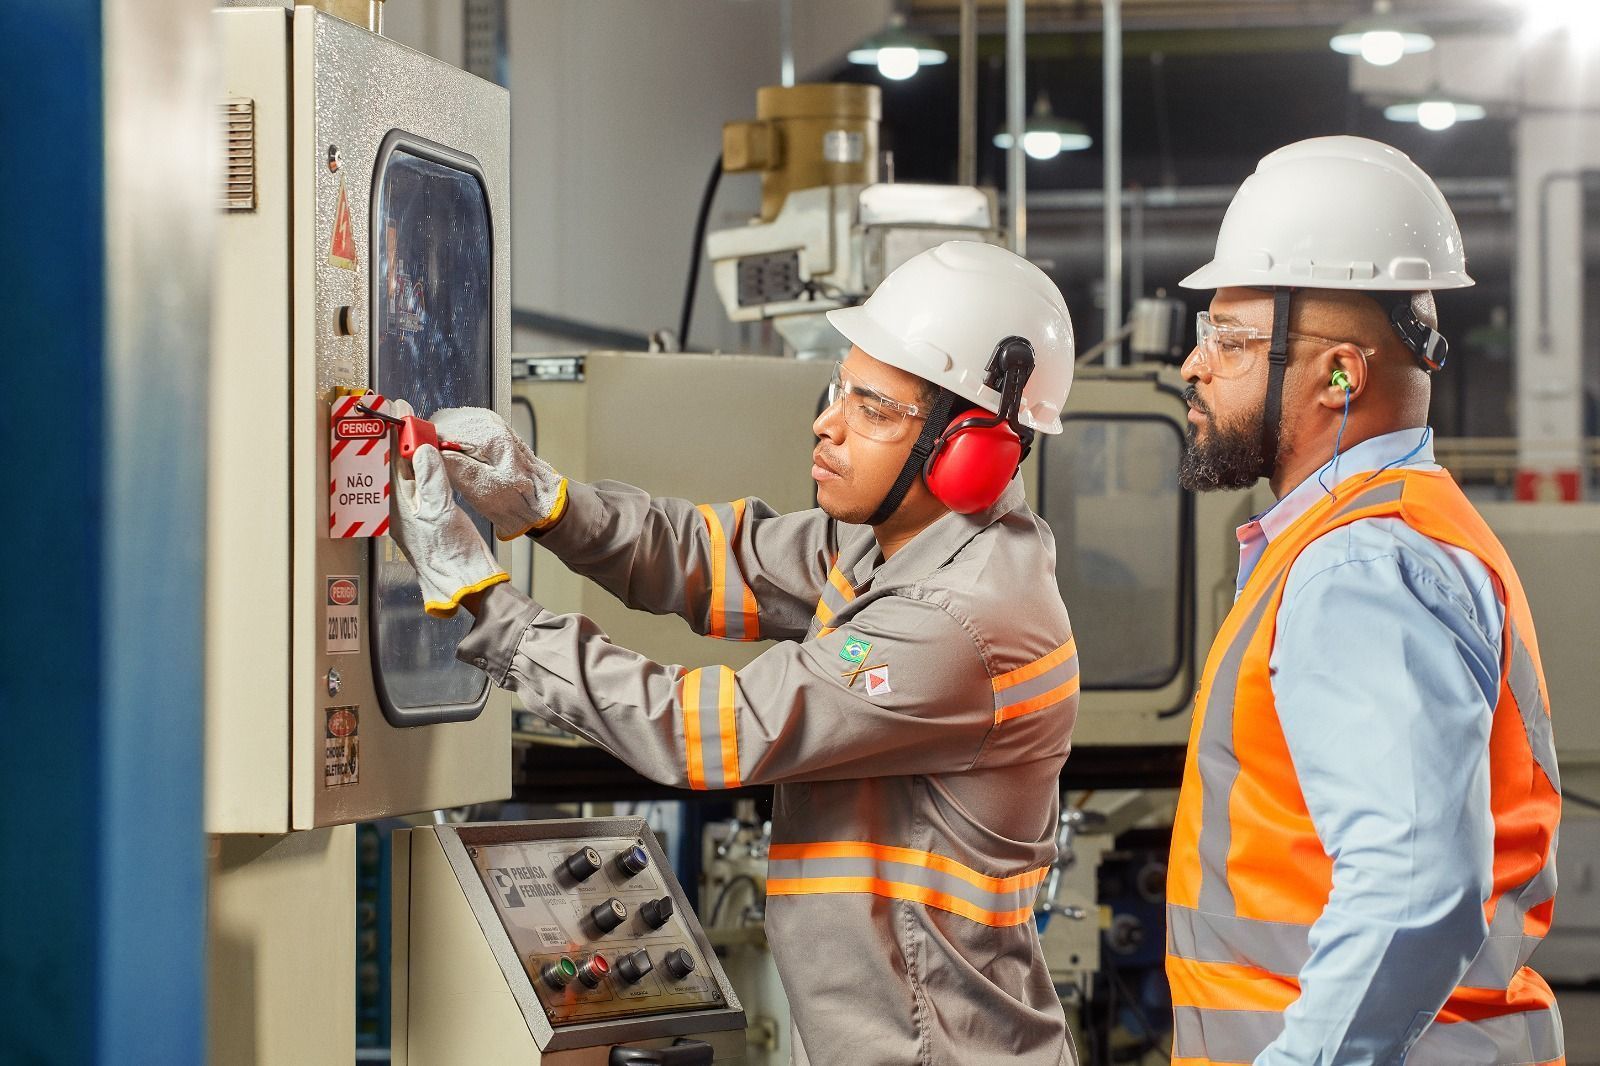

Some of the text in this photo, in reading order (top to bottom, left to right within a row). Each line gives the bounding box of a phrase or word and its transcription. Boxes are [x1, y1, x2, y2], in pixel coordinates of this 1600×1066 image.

[342, 422, 380, 434] PERIGO
[346, 473, 373, 488] NÃO
[339, 492, 381, 506] OPERE
[332, 586, 355, 599] PERIGO
[328, 616, 358, 640] 220 VOLTS
[510, 866, 547, 880] PRENSA
[519, 882, 562, 898] FERMASA
